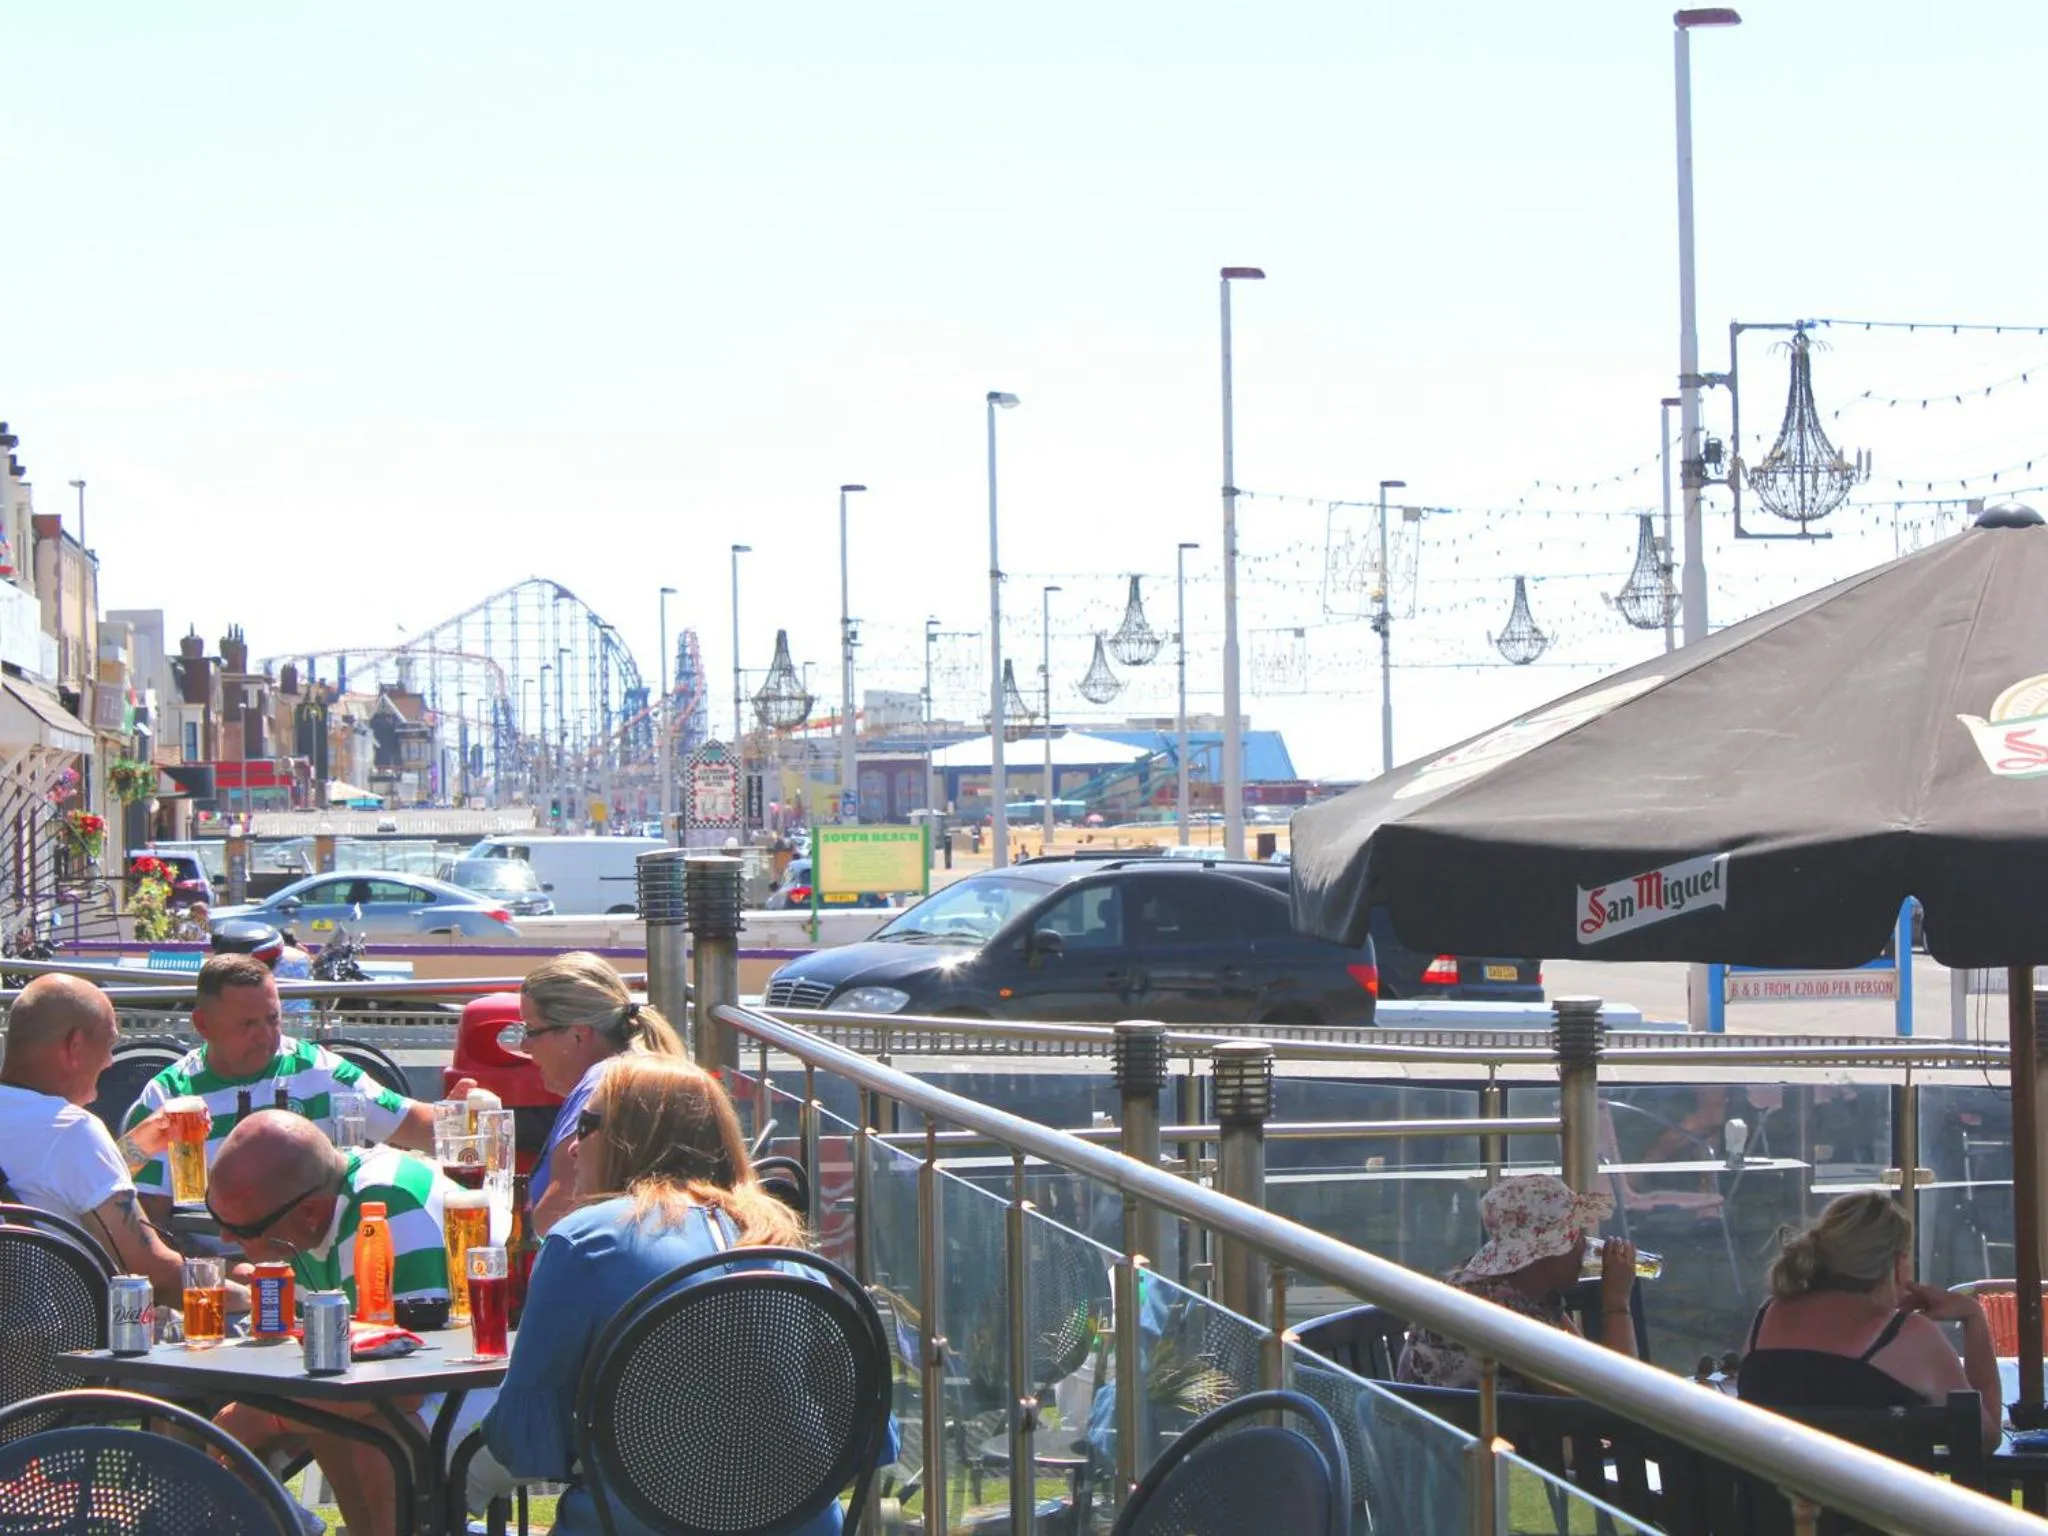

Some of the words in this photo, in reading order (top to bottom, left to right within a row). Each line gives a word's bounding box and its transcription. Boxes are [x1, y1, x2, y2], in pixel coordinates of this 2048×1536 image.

[822, 831, 869, 843] SOUTH
[871, 831, 919, 842] BEACH
[1580, 887, 1635, 934] San
[1632, 861, 1720, 910] Miguel
[1731, 983, 1738, 996] B
[1742, 983, 1749, 996] &
[1753, 982, 1760, 996] B
[1764, 981, 1791, 996] FROM
[1795, 980, 1829, 996] £20.00
[1832, 979, 1851, 995] PER
[1854, 979, 1893, 995] PERSON
[112, 1303, 142, 1325] Diet
